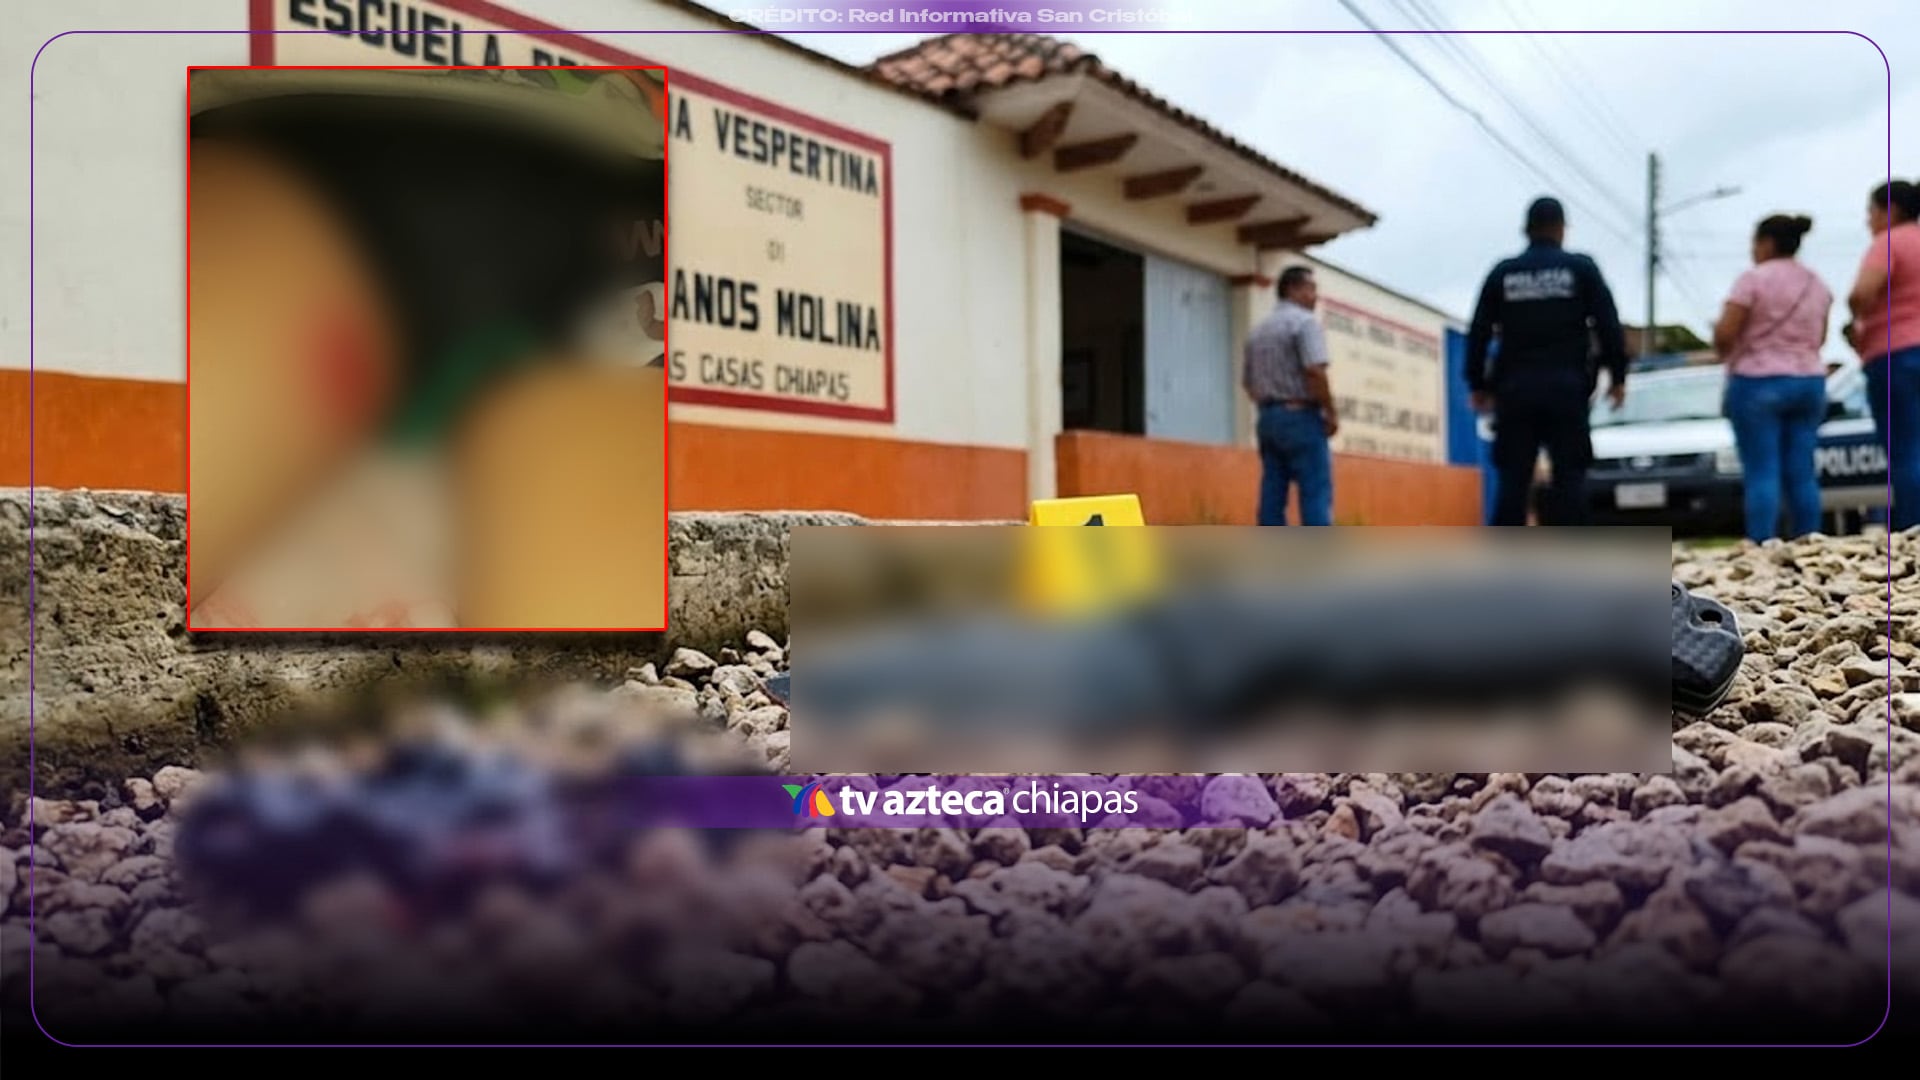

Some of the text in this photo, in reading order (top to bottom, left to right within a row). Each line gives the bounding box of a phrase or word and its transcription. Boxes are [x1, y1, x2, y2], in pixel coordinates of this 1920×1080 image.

[714, 108, 879, 197] VESPERTINA
[746, 185, 803, 219] SECTOR
[776, 287, 881, 351] MOLINA
[701, 354, 764, 390] CASAS
[775, 364, 849, 401] CHIAPAS
